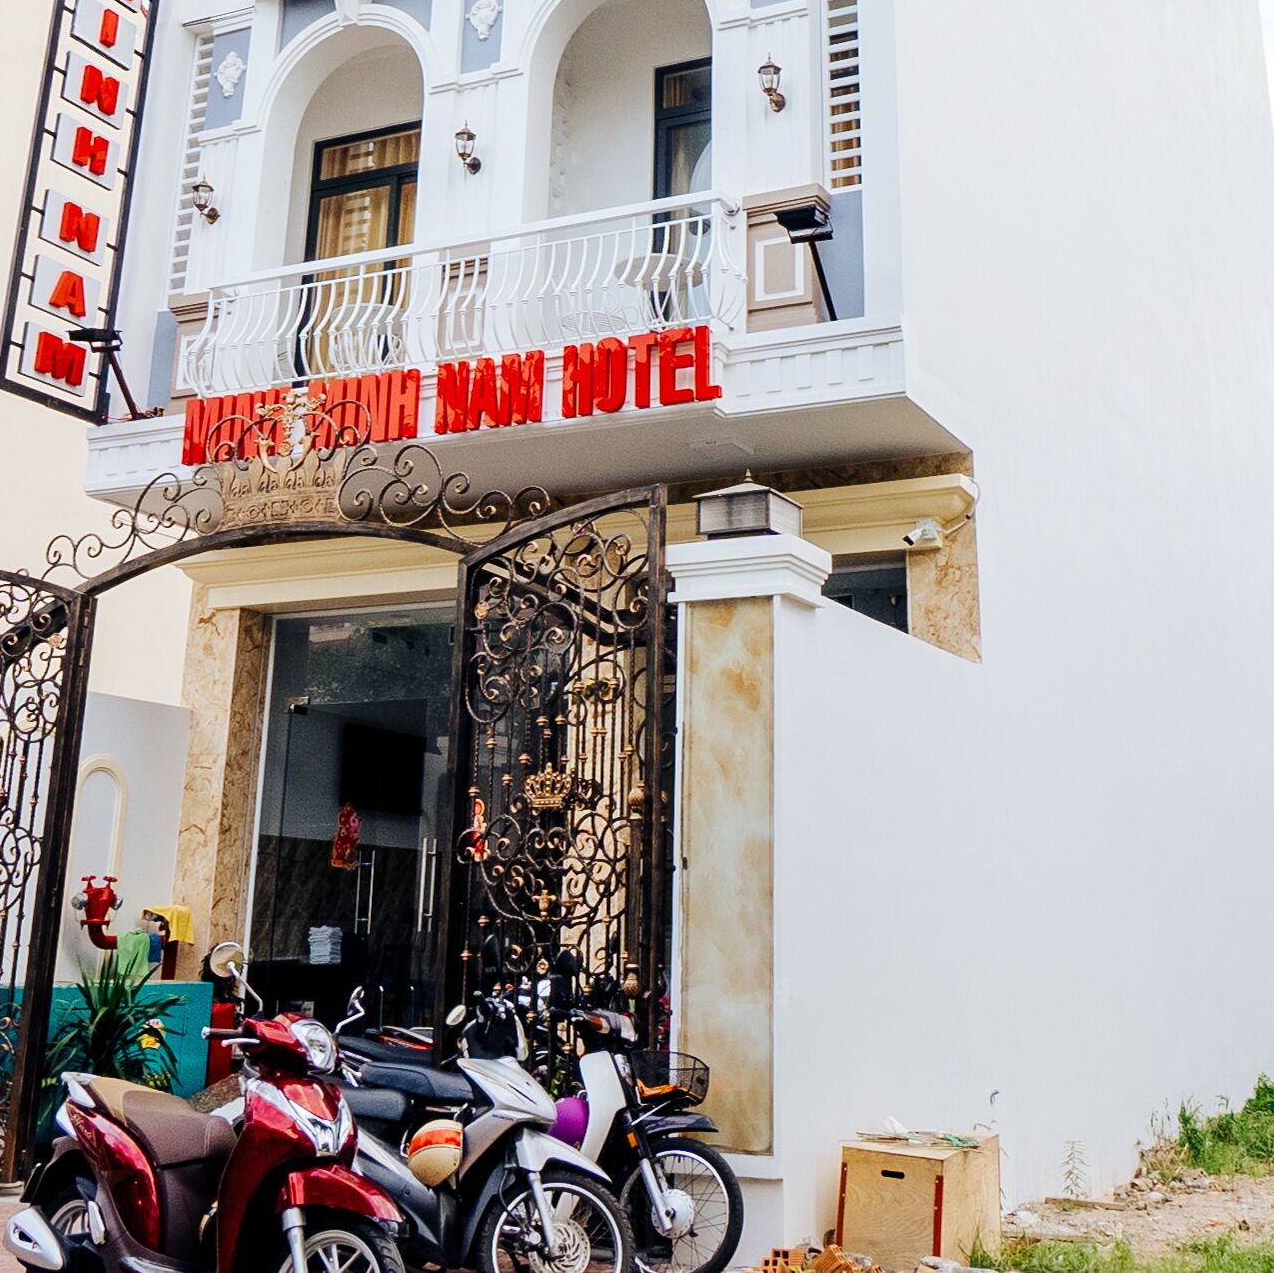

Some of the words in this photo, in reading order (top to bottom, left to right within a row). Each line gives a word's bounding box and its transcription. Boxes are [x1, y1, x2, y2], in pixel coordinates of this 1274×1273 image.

[34, 201, 100, 387] NAM
[182, 386, 294, 466] MINH
[306, 369, 421, 448] MINH
[434, 349, 545, 435] NAM
[562, 325, 723, 418] HOTEL
